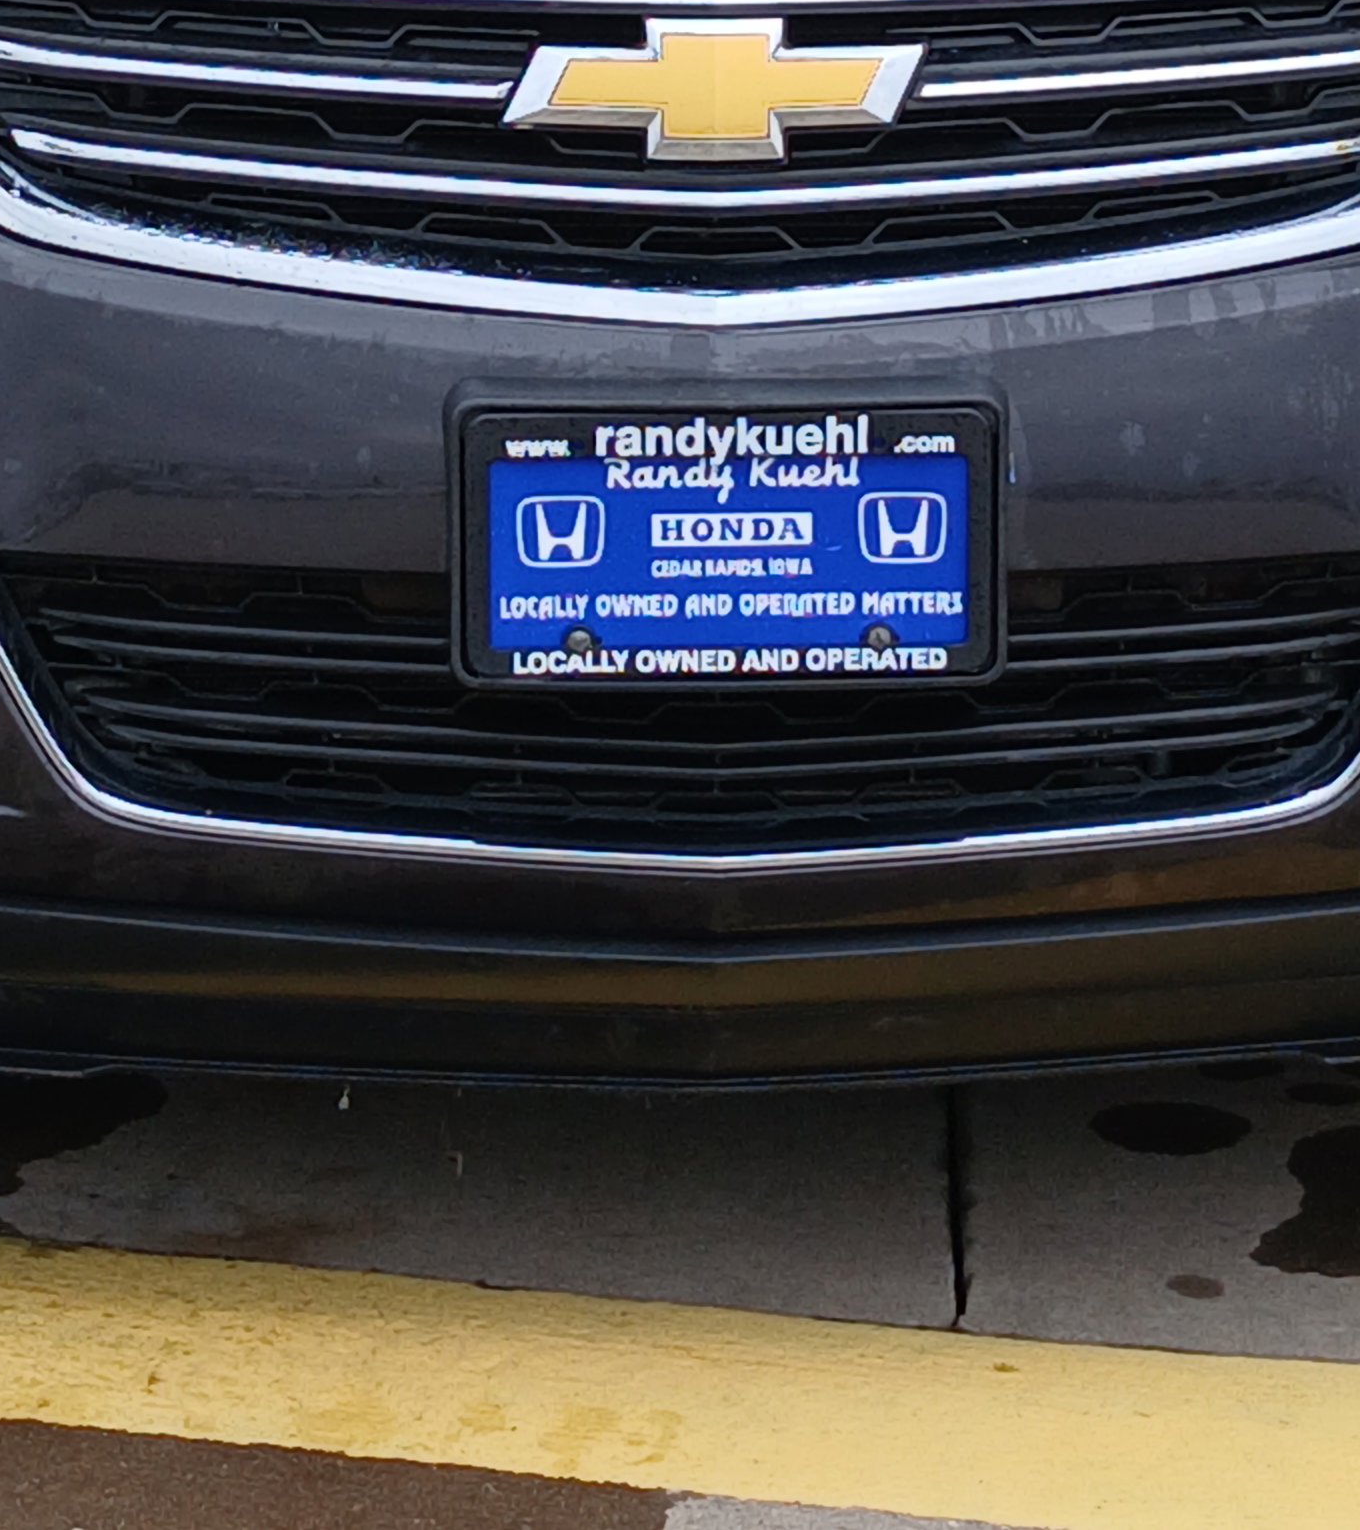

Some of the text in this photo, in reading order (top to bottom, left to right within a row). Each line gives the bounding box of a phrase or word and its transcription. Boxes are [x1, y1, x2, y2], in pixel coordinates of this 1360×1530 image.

[505, 414, 955, 466] www. randykuehl .com
[604, 456, 860, 504] Randy Kuehl
[660, 518, 805, 541] HONDA
[500, 590, 963, 620] LOCALLY OWNED AND OPERATED MATTERS
[513, 647, 948, 675] LOCALLY OWNED AND OPERATED
